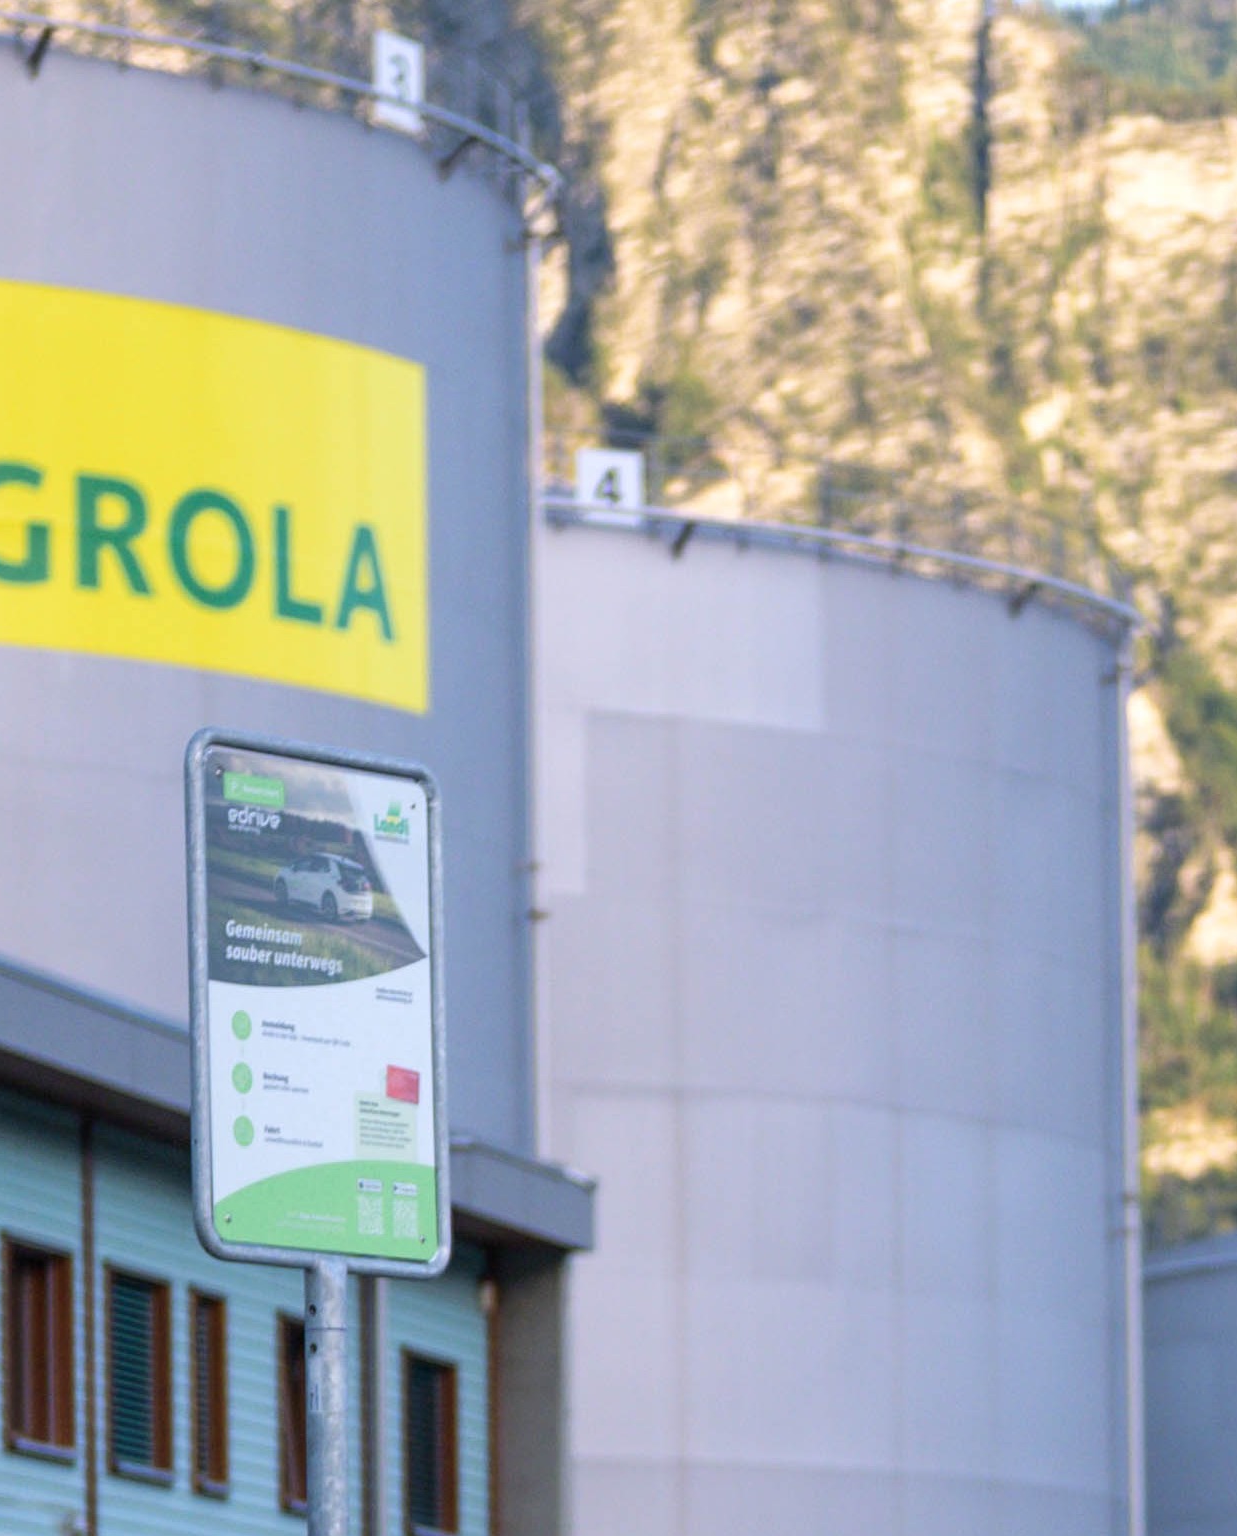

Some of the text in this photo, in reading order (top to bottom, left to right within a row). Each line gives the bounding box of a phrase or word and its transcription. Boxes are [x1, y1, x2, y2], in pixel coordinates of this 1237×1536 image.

[593, 466, 622, 504] 4
[227, 805, 282, 830] edrive
[225, 919, 303, 946] Gemeinsam
[225, 945, 344, 976] sauber unterwegs
